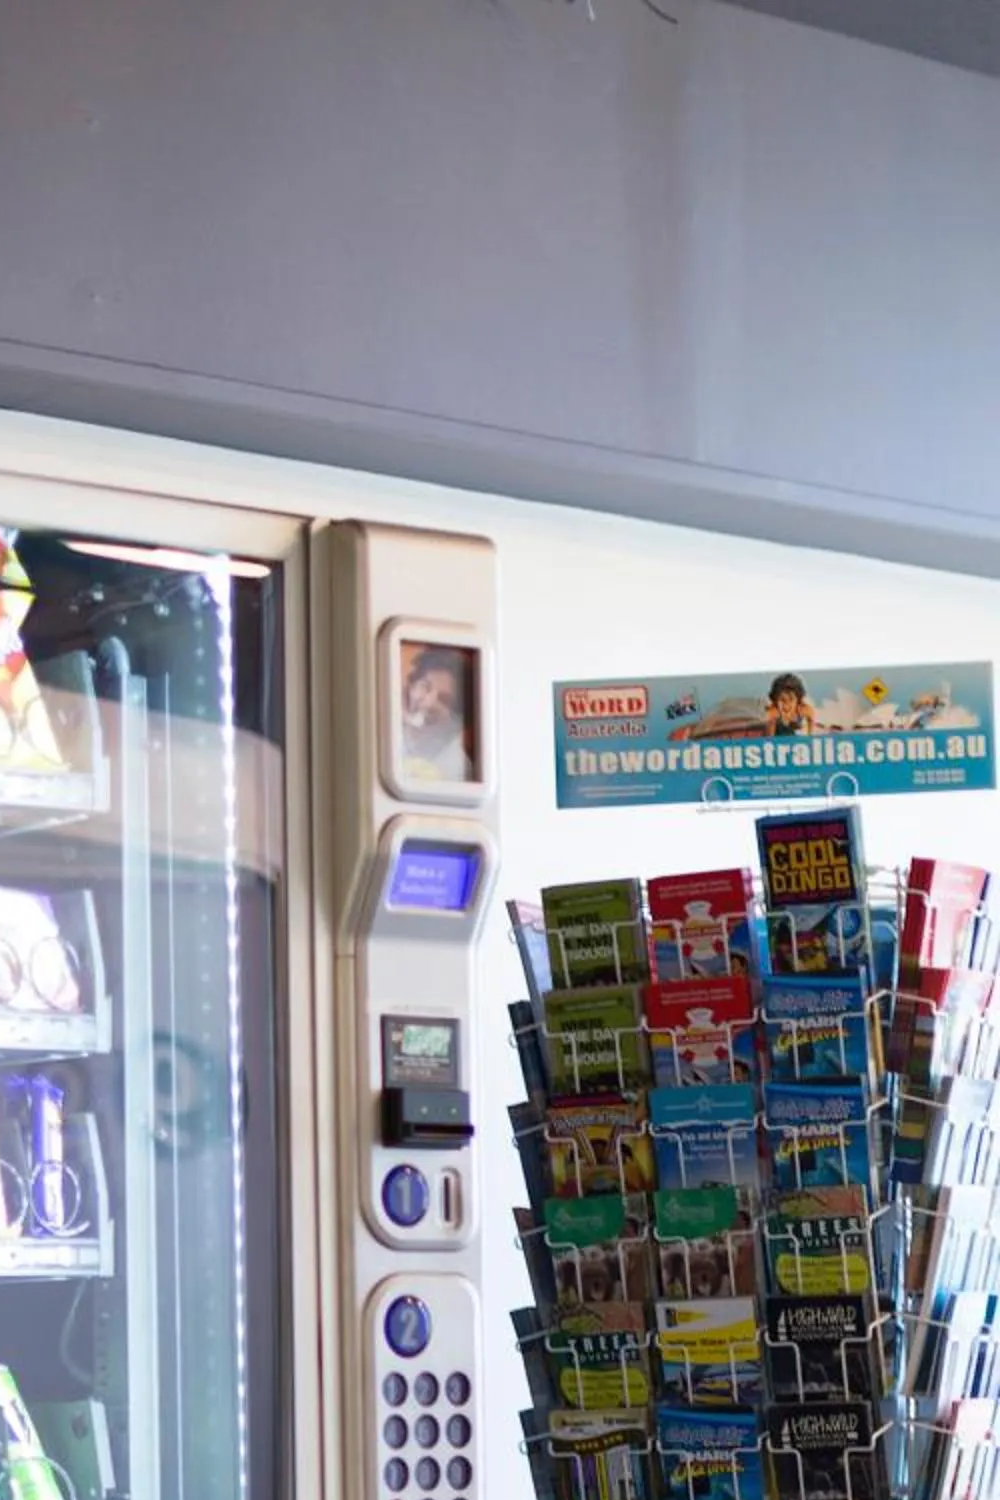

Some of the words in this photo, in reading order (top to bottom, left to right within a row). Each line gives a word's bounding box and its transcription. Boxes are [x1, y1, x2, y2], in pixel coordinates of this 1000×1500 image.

[570, 698, 643, 715] WORD
[567, 720, 648, 738] Australia
[565, 734, 987, 776] thewordaustralia.com.au
[768, 838, 848, 871] COOL
[772, 866, 850, 894] DINGO
[397, 1178, 411, 1215] 1
[400, 1309, 417, 1346] 2
